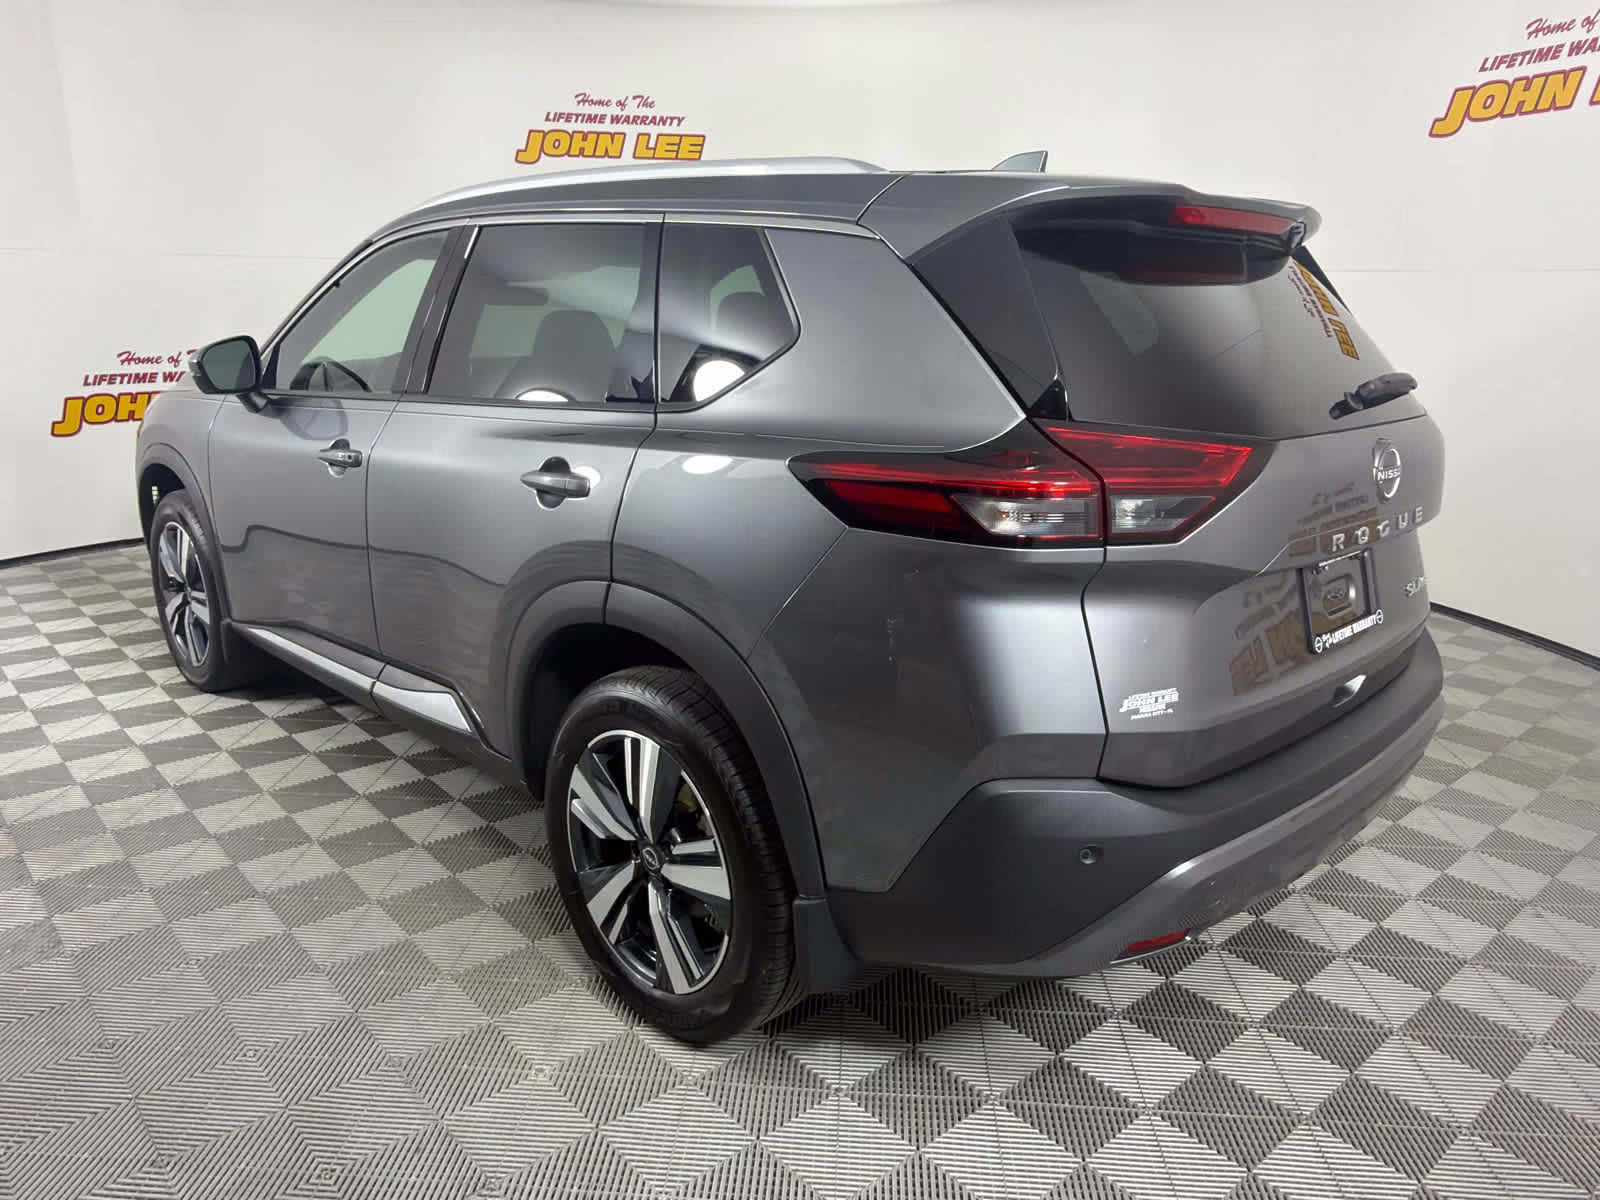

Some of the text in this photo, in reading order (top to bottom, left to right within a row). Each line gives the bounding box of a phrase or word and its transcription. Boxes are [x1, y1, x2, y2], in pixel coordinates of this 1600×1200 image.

[1526, 8, 1600, 40] Home of
[1478, 36, 1600, 73] LIFETIME WA
[574, 92, 656, 111] Home of The
[1428, 65, 1588, 139] JOHN
[544, 111, 685, 127] LIFETIME WARRANTY
[515, 129, 706, 164] JOHN LEE
[117, 350, 164, 366] Home
[167, 351, 182, 368] of
[83, 371, 158, 386] LIFETIME
[51, 391, 160, 438] JOH
[1377, 469, 1401, 481] NISS
[1332, 506, 1424, 551] ROGUE
